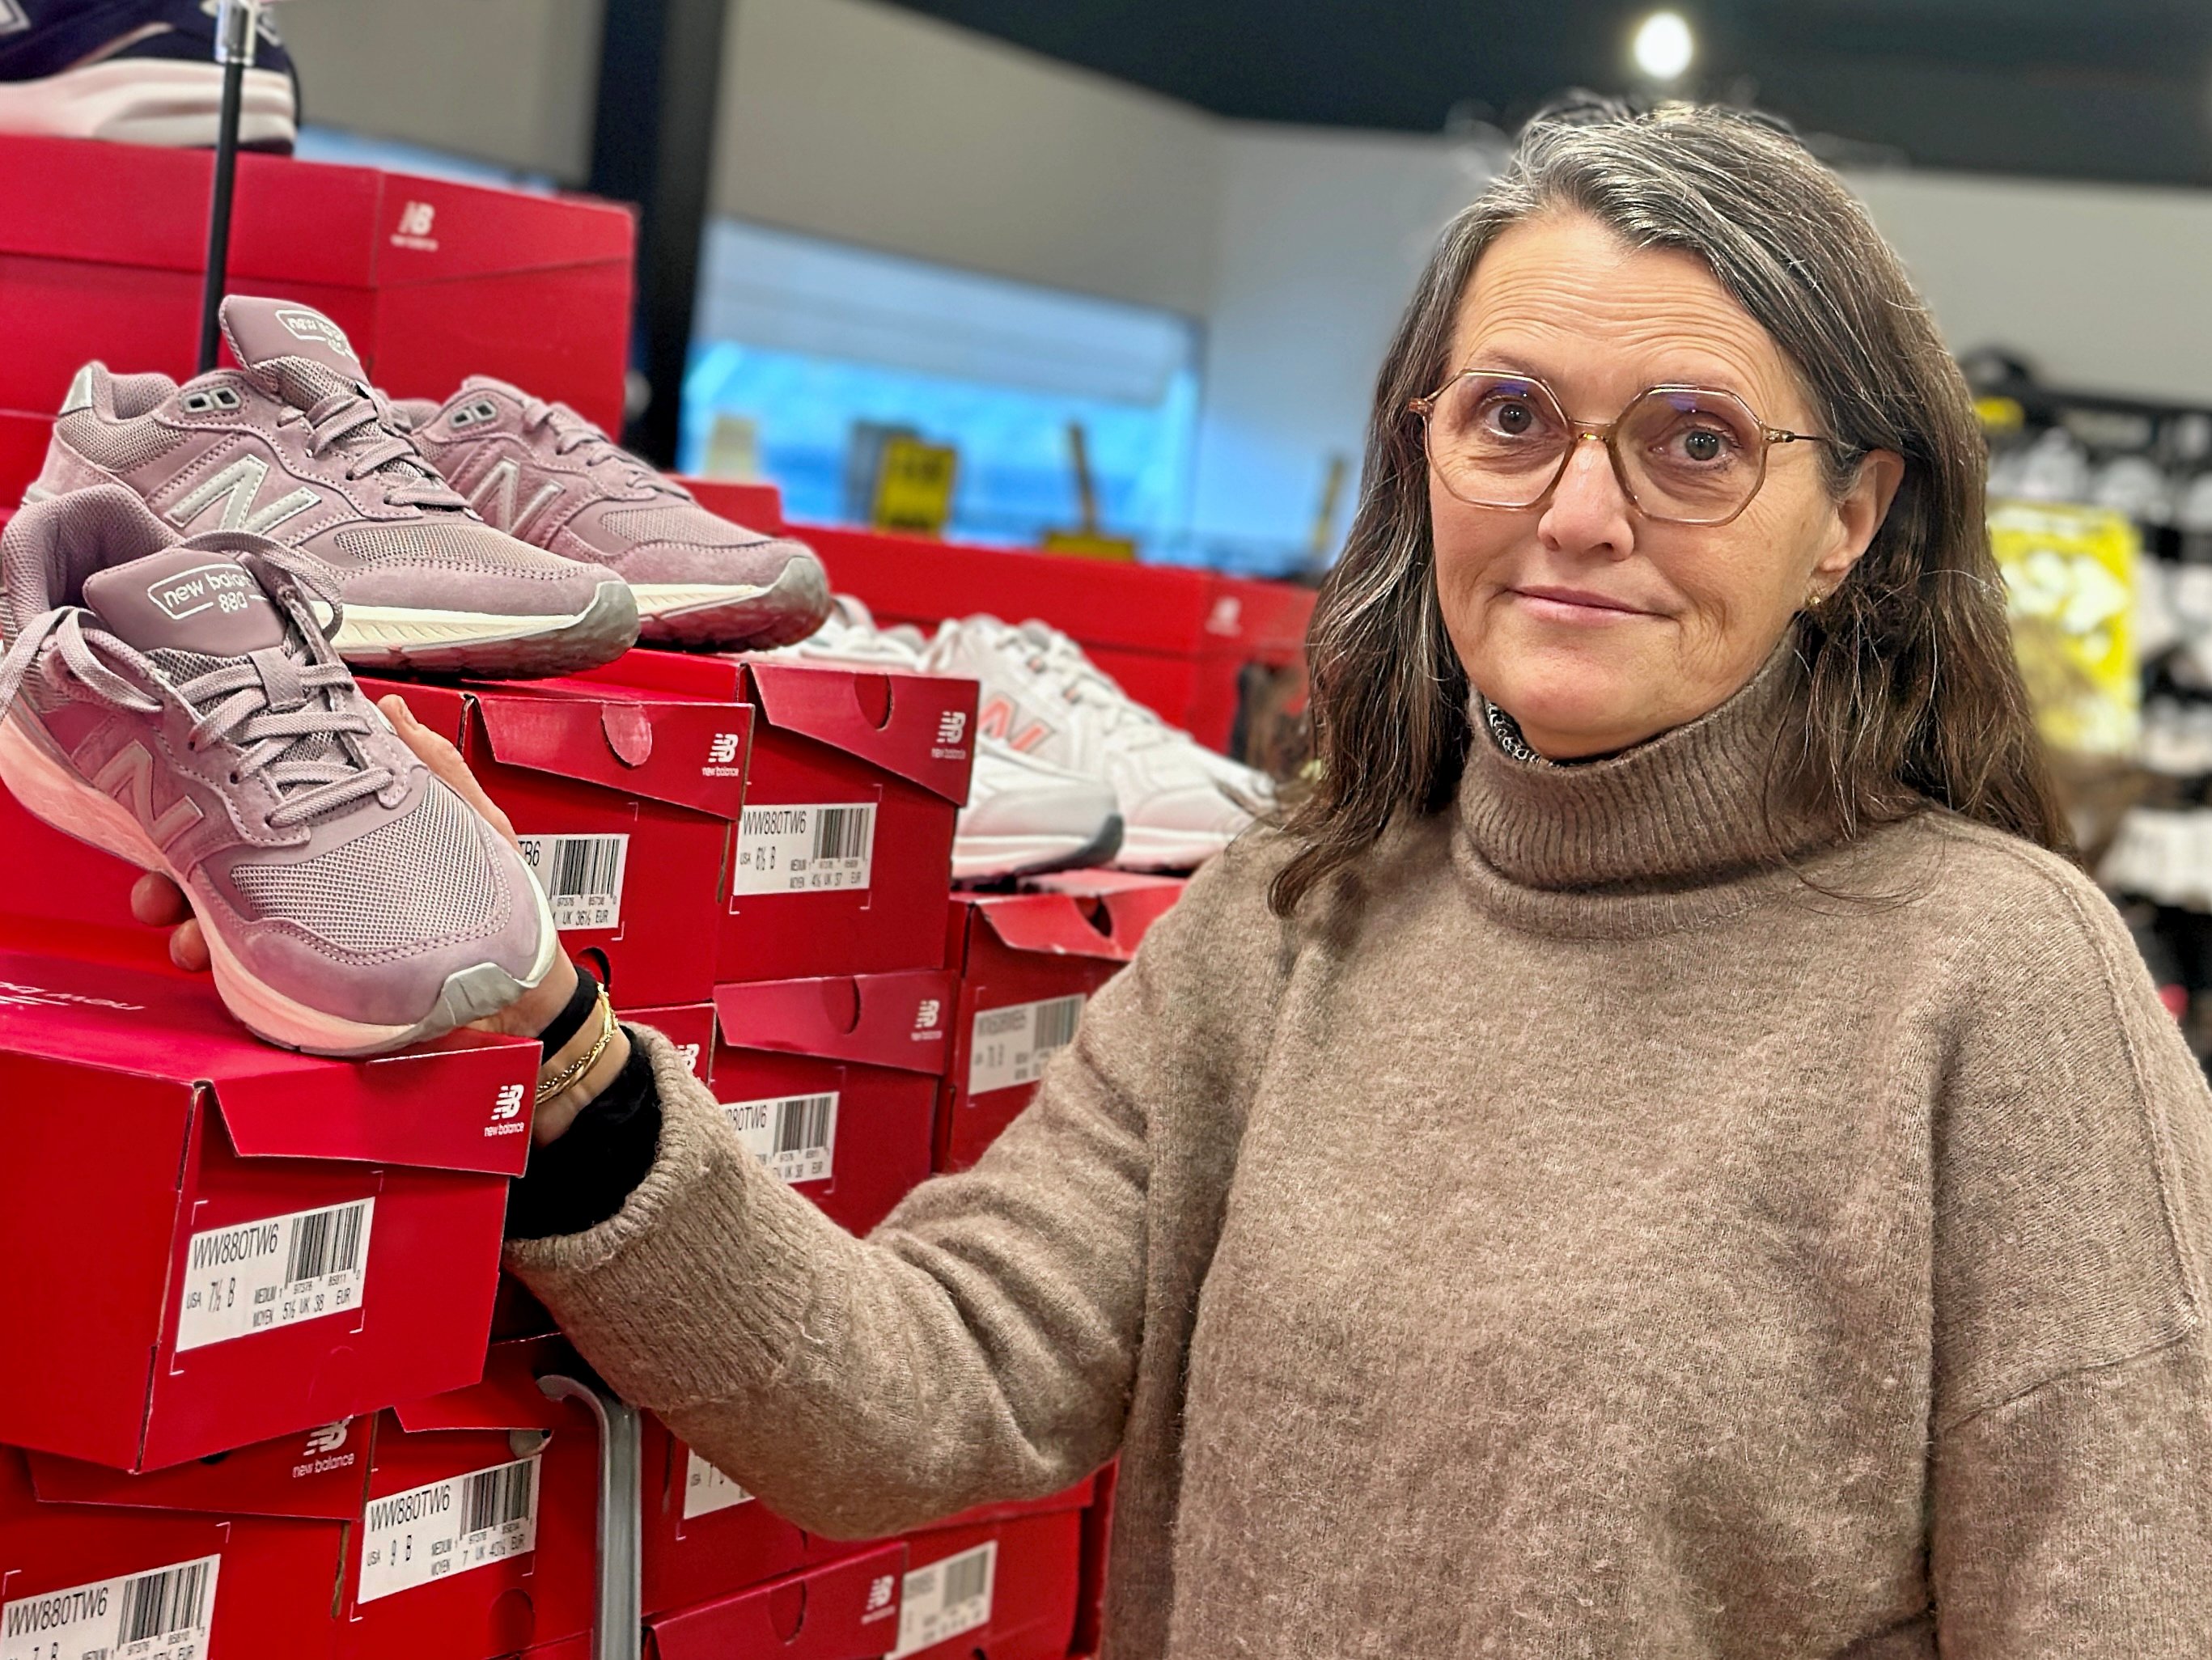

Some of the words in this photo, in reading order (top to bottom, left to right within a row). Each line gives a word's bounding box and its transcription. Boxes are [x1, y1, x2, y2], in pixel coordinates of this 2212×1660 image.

[163, 579, 204, 608] new
[218, 591, 248, 612] 880
[744, 811, 807, 836] WW880TW6
[739, 852, 752, 866] USA
[769, 845, 777, 870] B
[562, 911, 573, 925] UK
[595, 908, 608, 924] EUR
[484, 1126, 498, 1137] new
[498, 1121, 525, 1136] balance
[193, 1222, 279, 1271] WW880TW6
[186, 1292, 201, 1310] USA
[227, 1277, 236, 1308] B
[254, 1285, 278, 1305] MEDIUM
[252, 1308, 274, 1328] MOYEN
[300, 1297, 311, 1314] UK
[314, 1294, 324, 1312] 38
[336, 1288, 351, 1305] EUR
[292, 1463, 315, 1478] new
[314, 1453, 355, 1473] balance
[371, 1484, 451, 1532] WW880TW6
[367, 1549, 381, 1567] USA
[390, 1539, 396, 1566] 9
[405, 1535, 412, 1561] B
[463, 1549, 468, 1567] 7
[7, 1586, 108, 1638] WW880TW6
